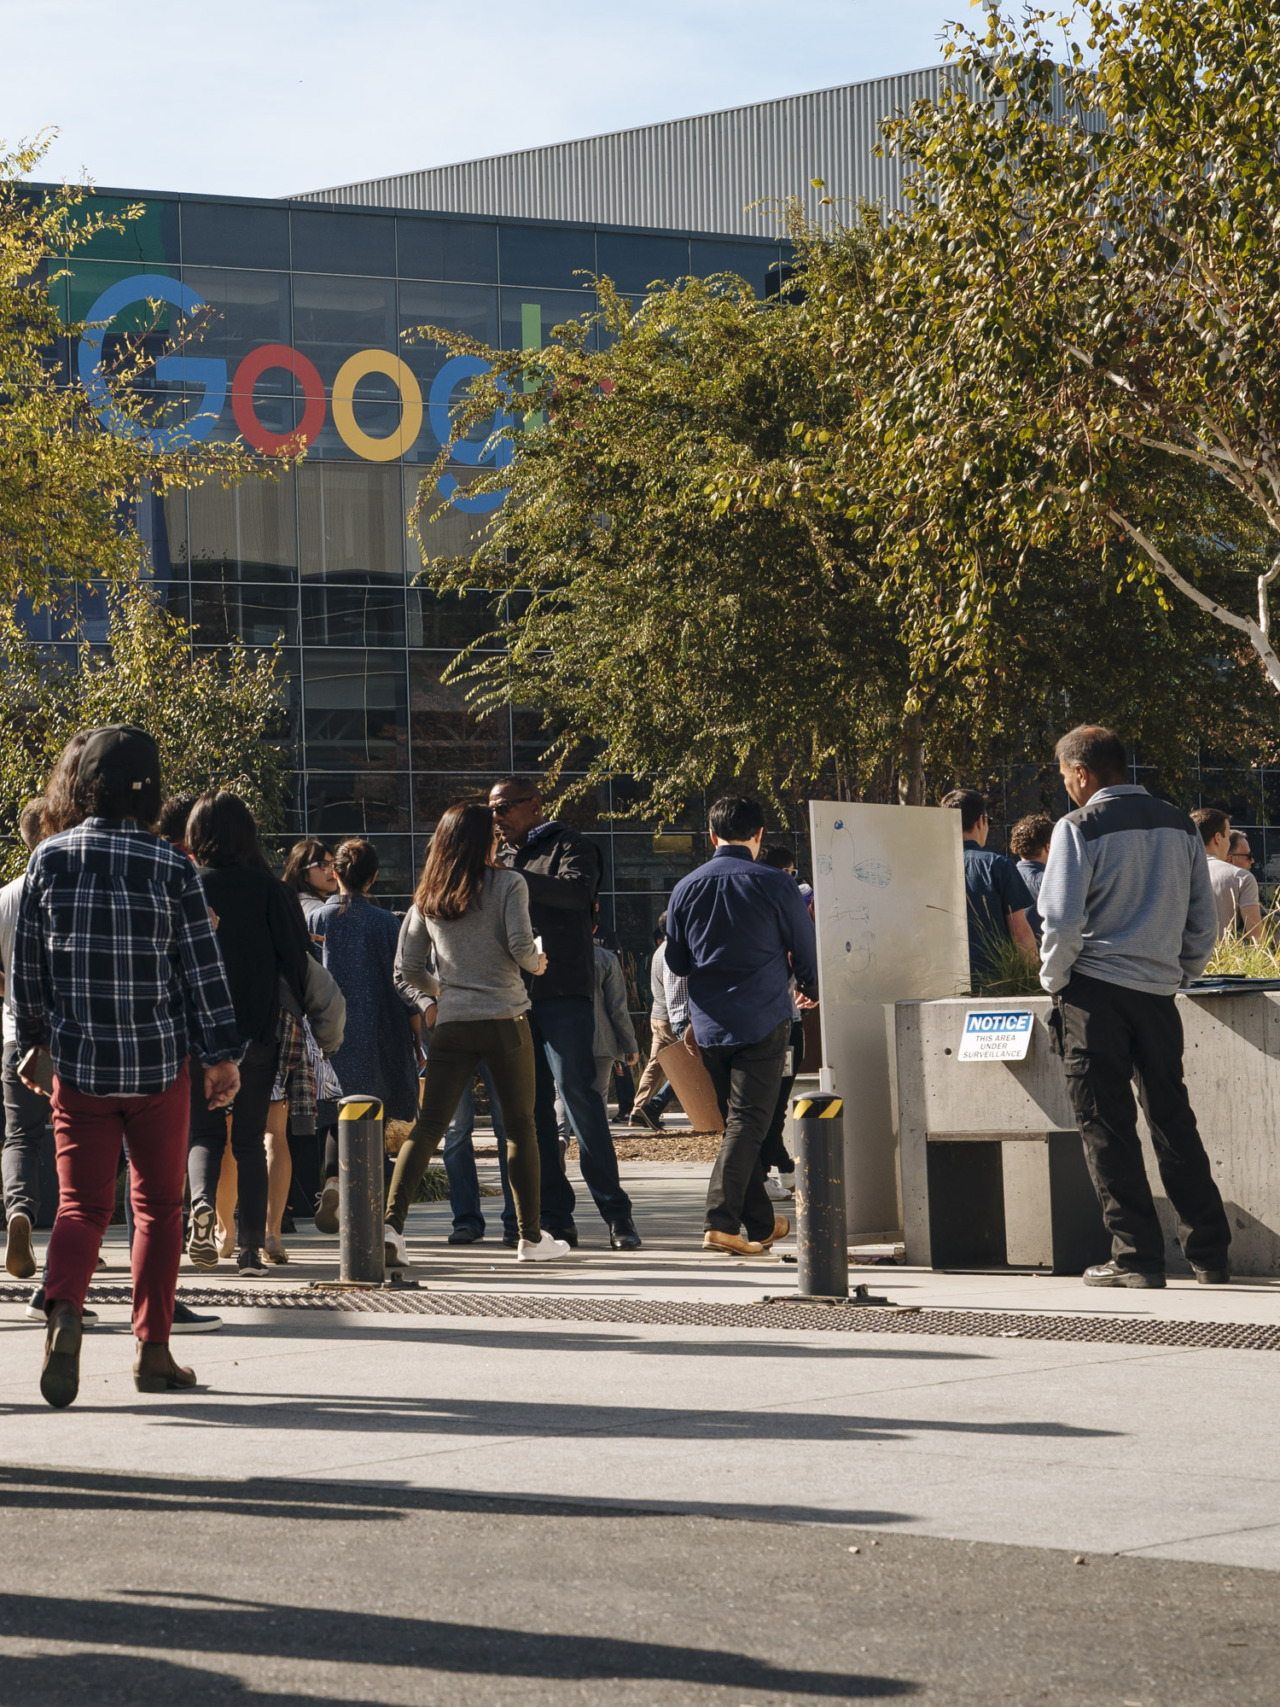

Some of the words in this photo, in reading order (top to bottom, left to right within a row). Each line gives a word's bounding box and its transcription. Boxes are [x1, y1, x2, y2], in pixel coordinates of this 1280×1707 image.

[78, 274, 616, 514] Googl
[969, 1015, 1028, 1031] NOTICE
[995, 1034, 1016, 1042] AREA
[980, 1042, 1008, 1050] UNDER
[963, 1050, 1022, 1058] SURVEILLANCE
